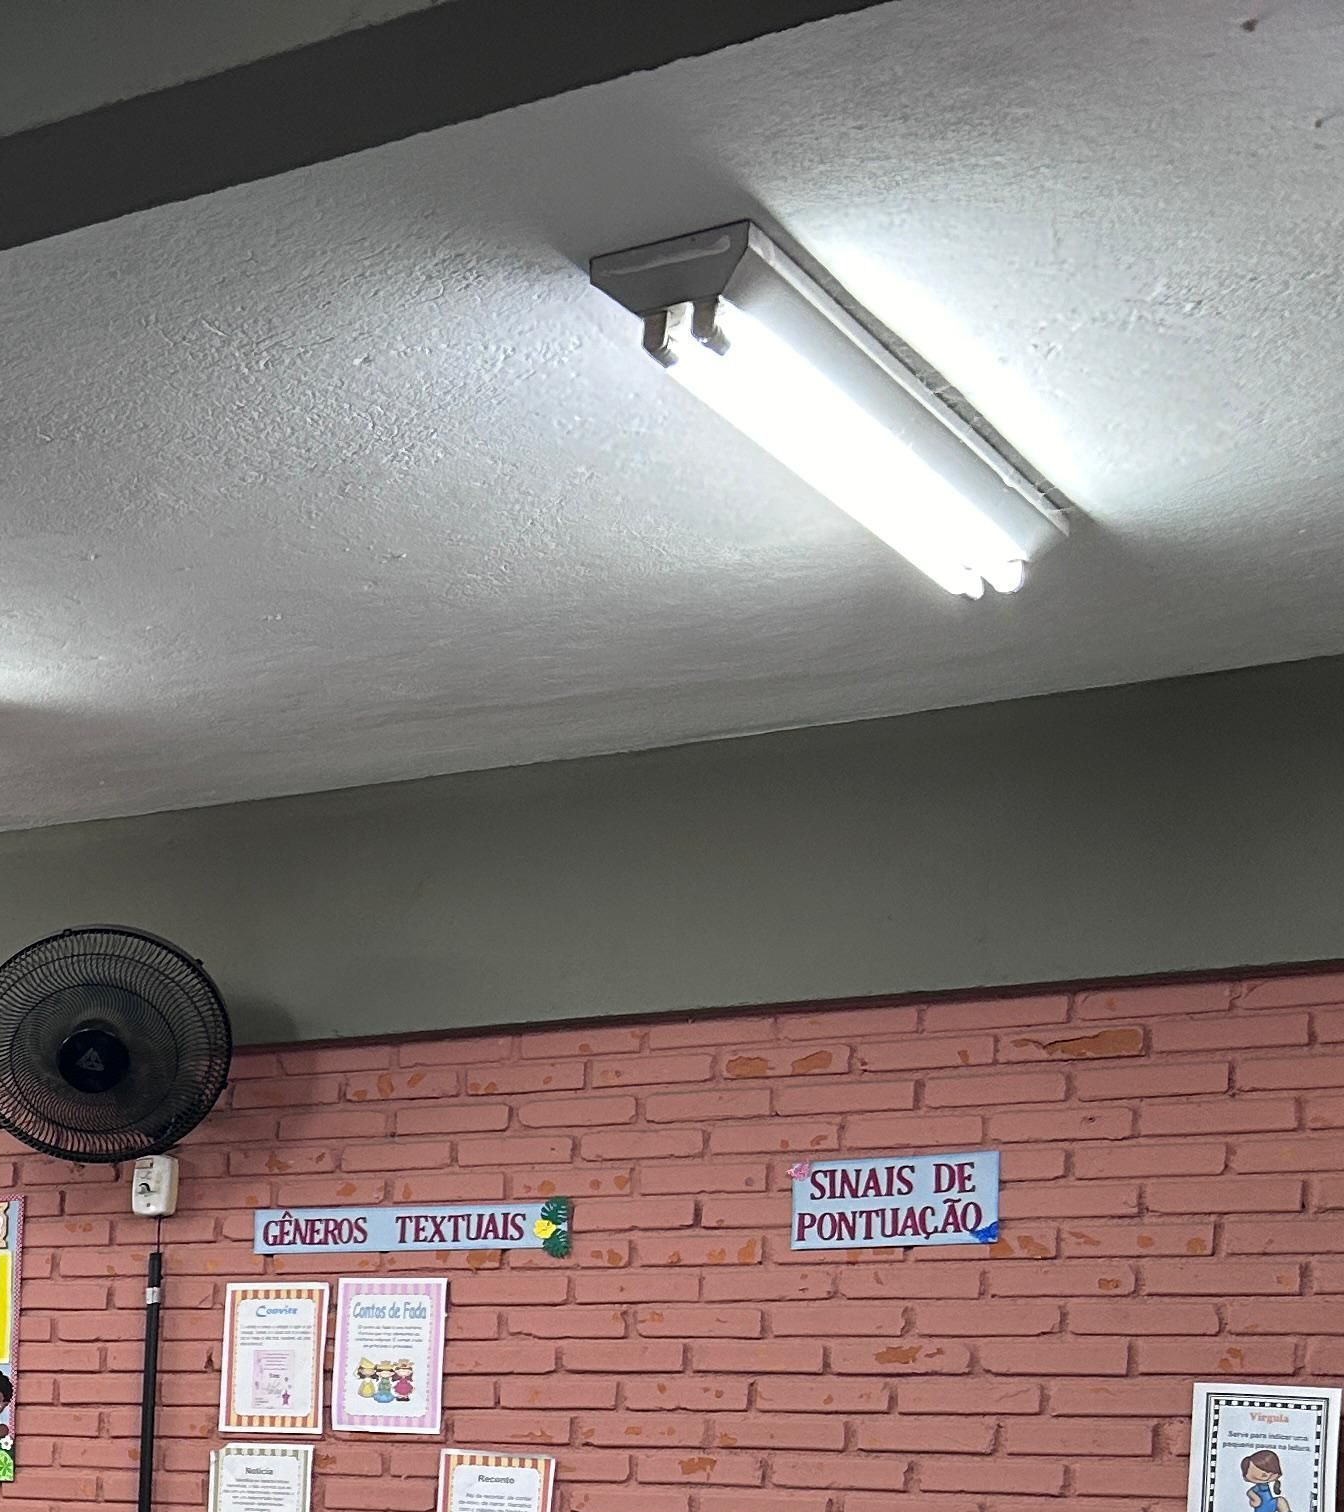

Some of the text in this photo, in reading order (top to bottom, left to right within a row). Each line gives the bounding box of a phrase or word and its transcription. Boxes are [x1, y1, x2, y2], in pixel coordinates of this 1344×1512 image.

[810, 1162, 976, 1200] SINAIS DE
[263, 1211, 526, 1247] GÊNEROS TEXTUAIS
[796, 1198, 982, 1242] PONTUAÇÃO
[353, 1302, 427, 1320] Contos de Fada
